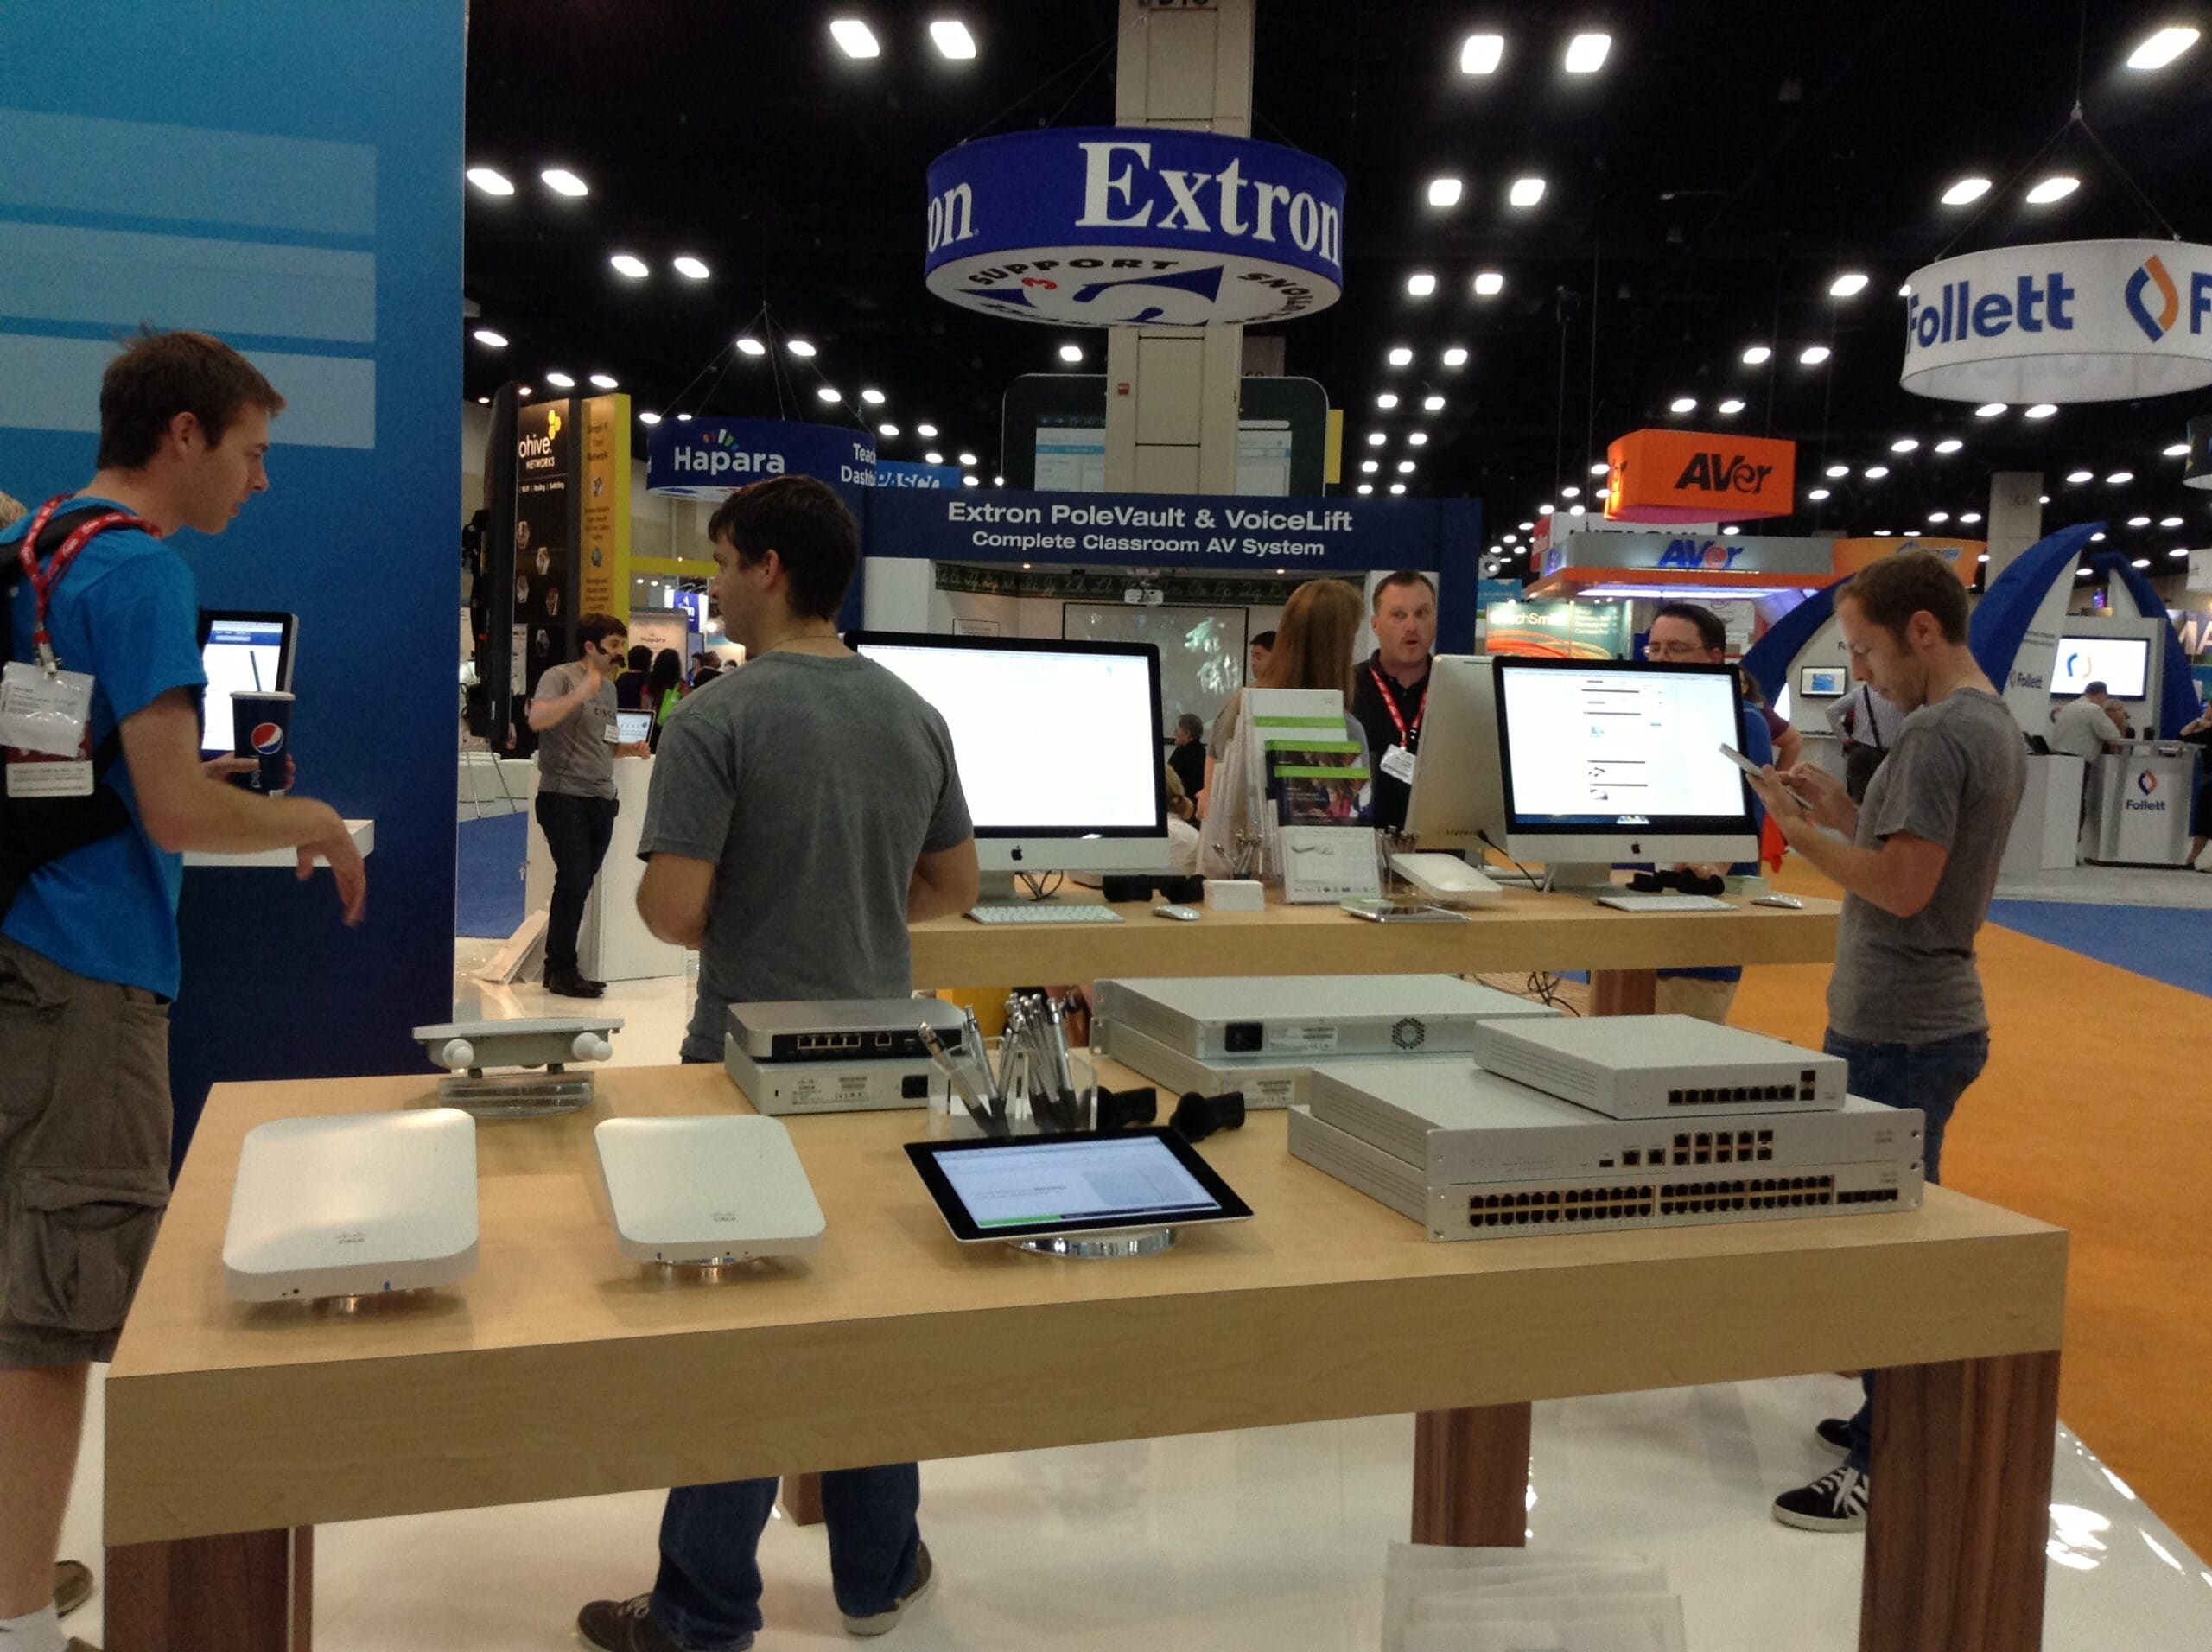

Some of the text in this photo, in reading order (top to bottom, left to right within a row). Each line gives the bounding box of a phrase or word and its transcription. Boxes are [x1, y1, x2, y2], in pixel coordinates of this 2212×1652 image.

[928, 181, 974, 254] on
[1075, 141, 1341, 266] Extron
[969, 258, 1180, 286] SUPPORT
[1906, 272, 2074, 354] Follett
[526, 456, 556, 470] NETWORKS
[675, 446, 785, 475] Hapara
[1675, 453, 1773, 494] AVer
[949, 501, 1353, 531] Extron PoleVault & VoiceLift
[972, 531, 1325, 557] Complete Classroom AV System
[1658, 539, 1744, 569] AVer
[2126, 799, 2166, 810] Follett
